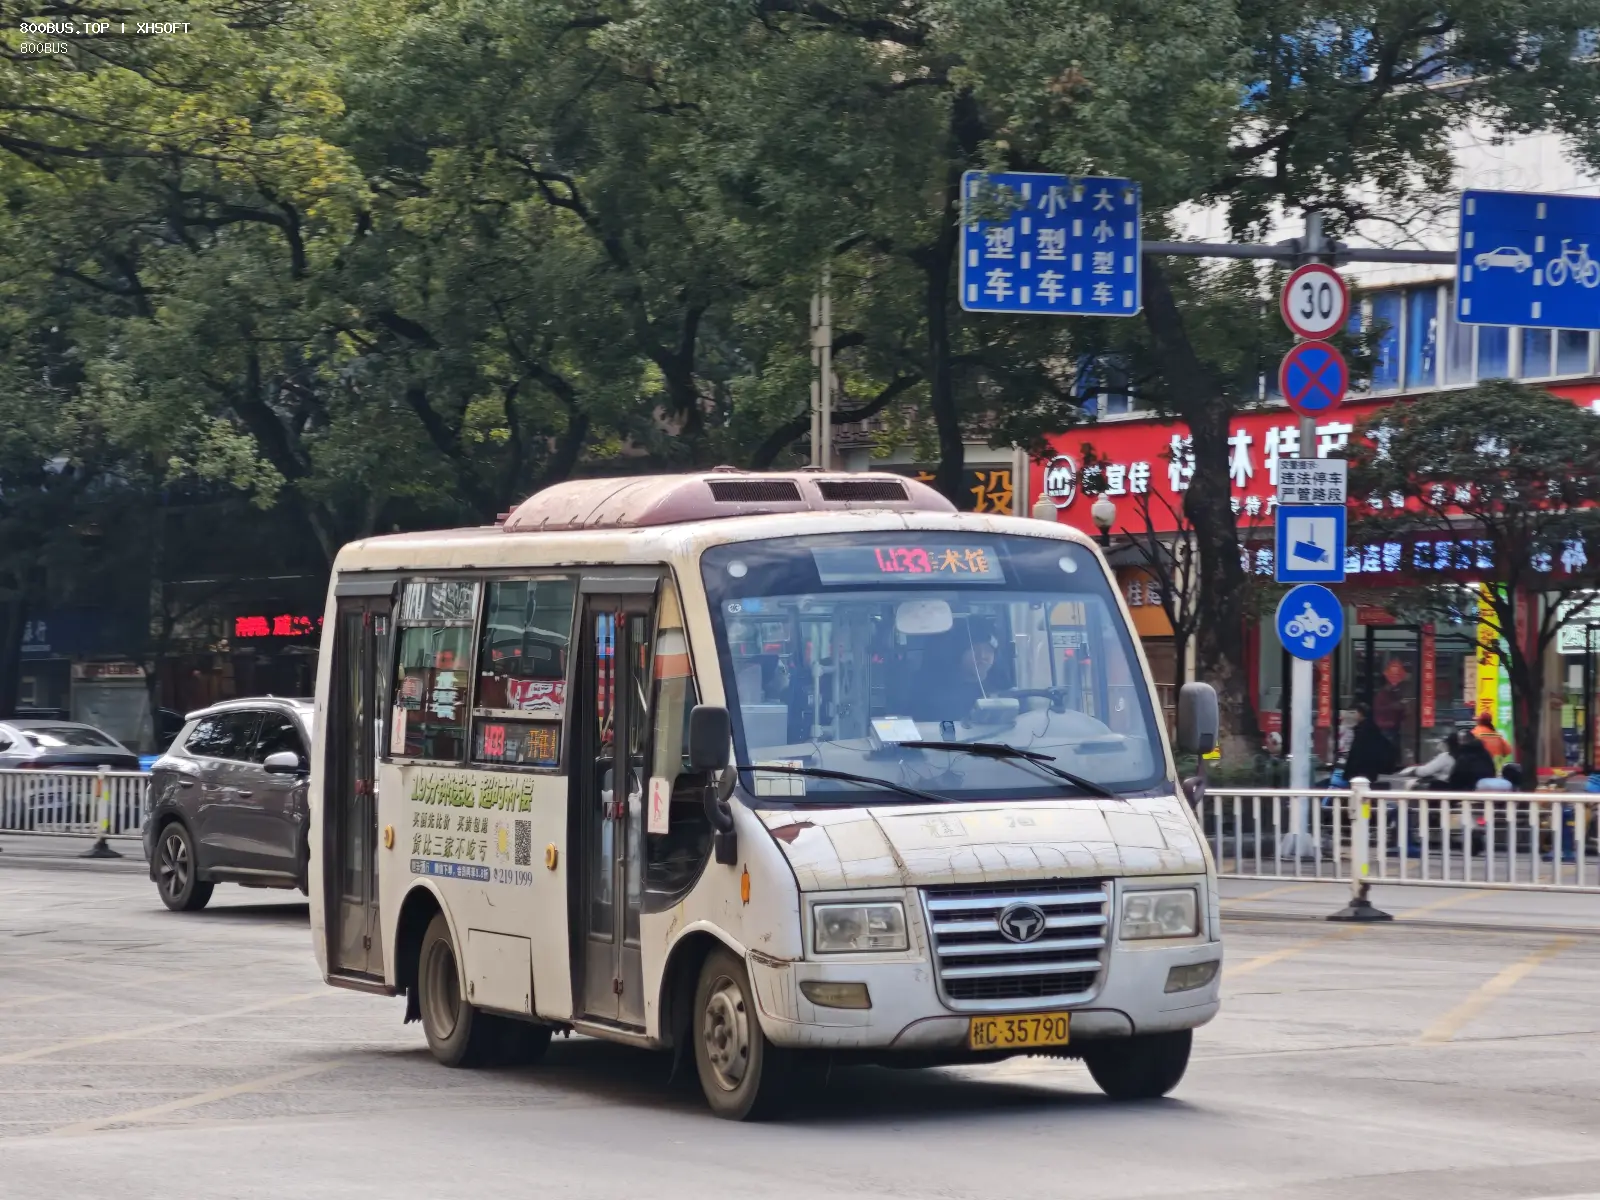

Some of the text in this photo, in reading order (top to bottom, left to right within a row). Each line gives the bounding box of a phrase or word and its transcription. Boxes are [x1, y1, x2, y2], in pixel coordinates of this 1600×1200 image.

[1036, 185, 1067, 304] 小型车
[1091, 187, 1115, 306] 大小型车
[1301, 281, 1333, 320] 30
[1280, 471, 1343, 486] 违法停车
[1281, 487, 1342, 502] 严管路段
[411, 832, 488, 862] 货比三家不吃亏
